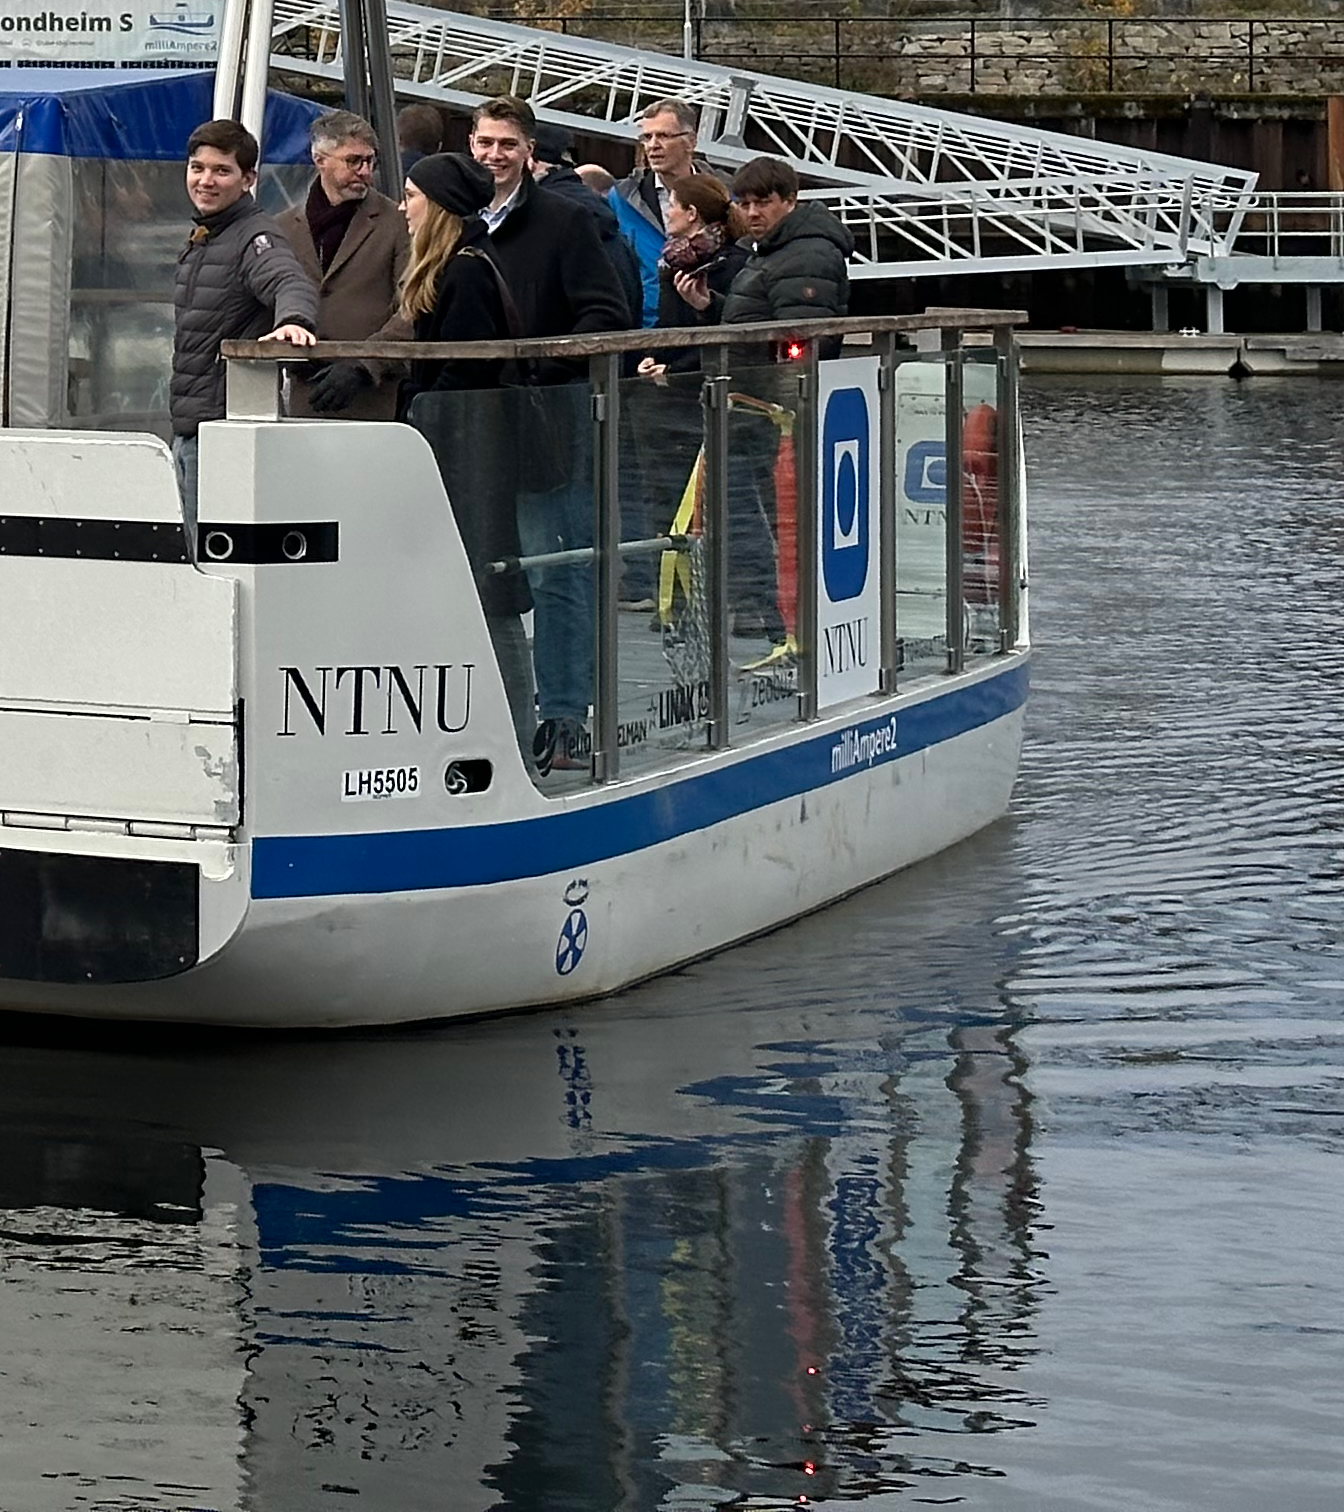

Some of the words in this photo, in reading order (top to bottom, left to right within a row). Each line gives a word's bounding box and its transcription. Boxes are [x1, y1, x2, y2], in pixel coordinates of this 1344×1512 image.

[119, 12, 134, 32] S
[823, 617, 869, 678] NTNU
[276, 664, 476, 736] NTNU
[830, 716, 898, 774] milliAmpere2
[344, 767, 419, 796] LH5505
